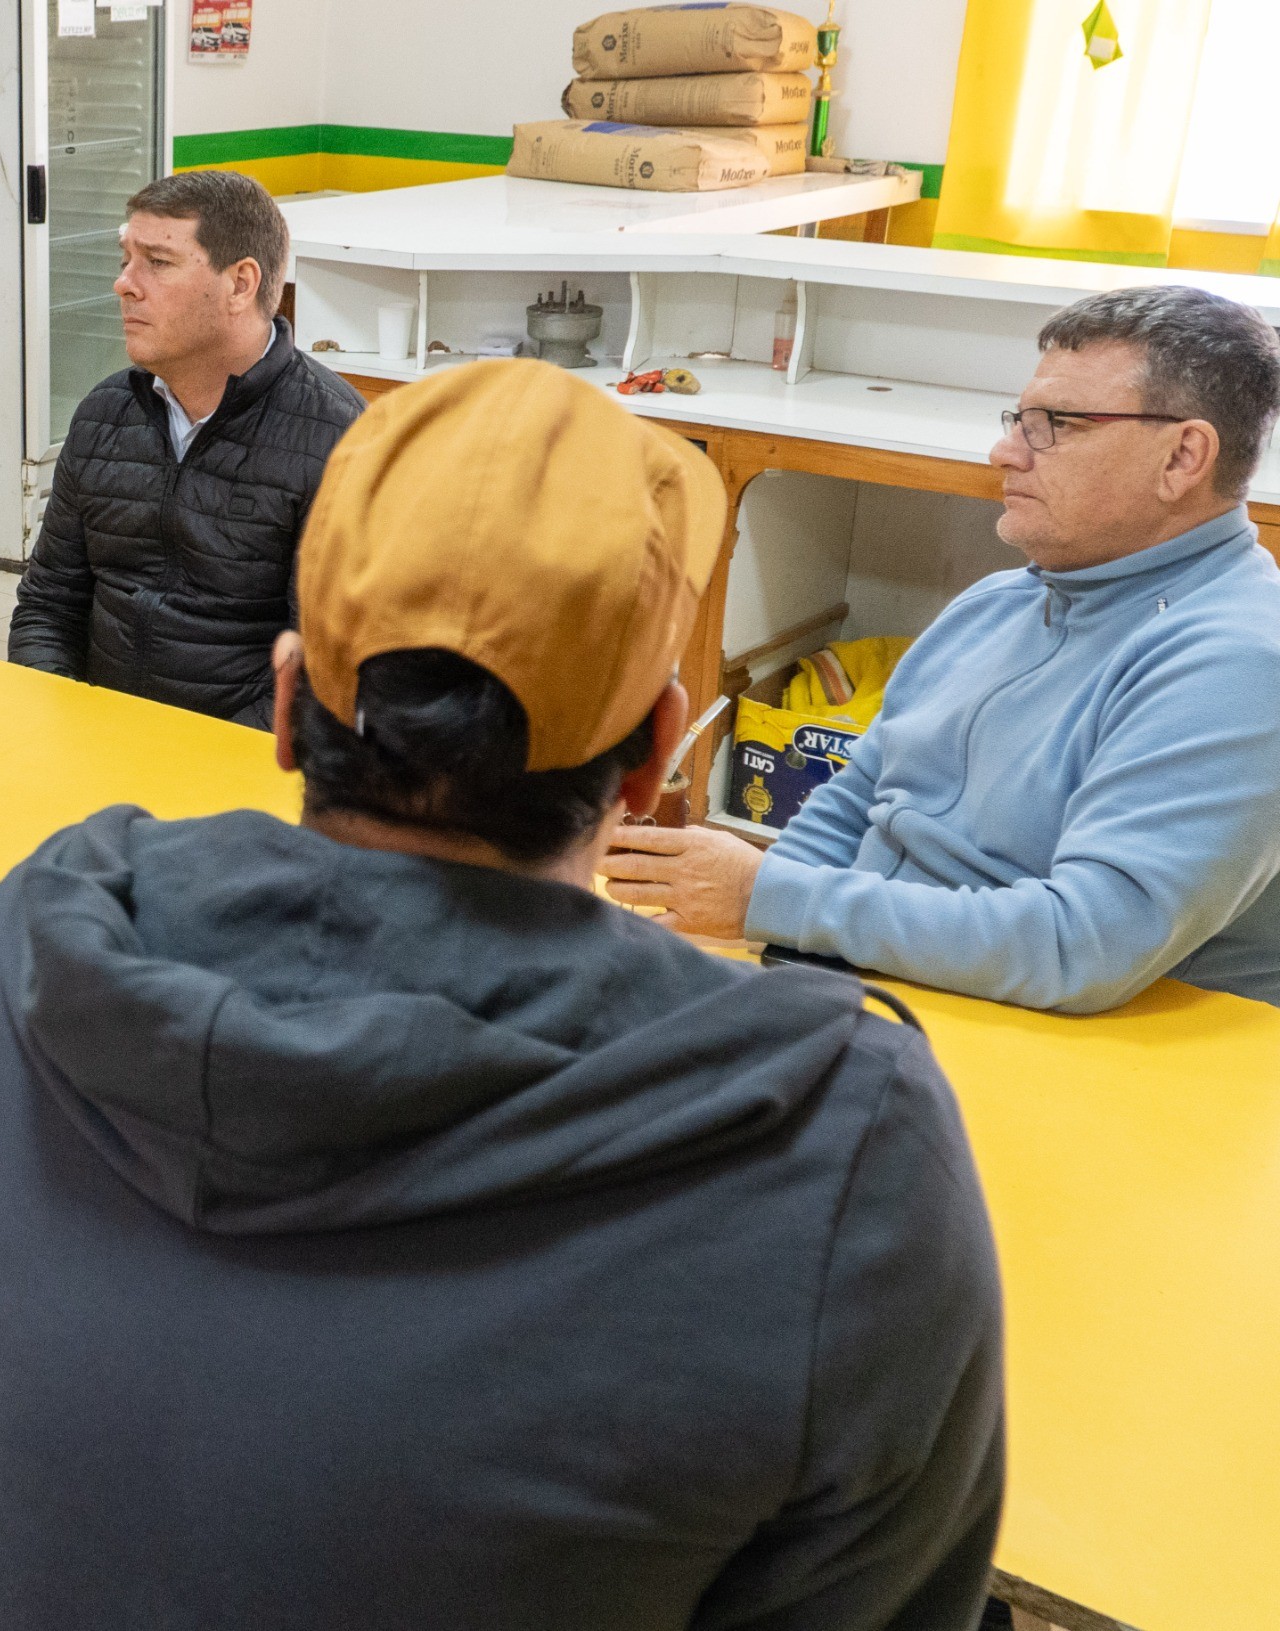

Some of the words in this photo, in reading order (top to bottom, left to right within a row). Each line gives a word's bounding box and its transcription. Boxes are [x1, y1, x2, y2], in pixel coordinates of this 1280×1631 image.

[618, 21, 630, 63] Morixe
[782, 86, 807, 99] Morixe
[776, 139, 802, 153] Morixe
[720, 167, 756, 182] Morixe
